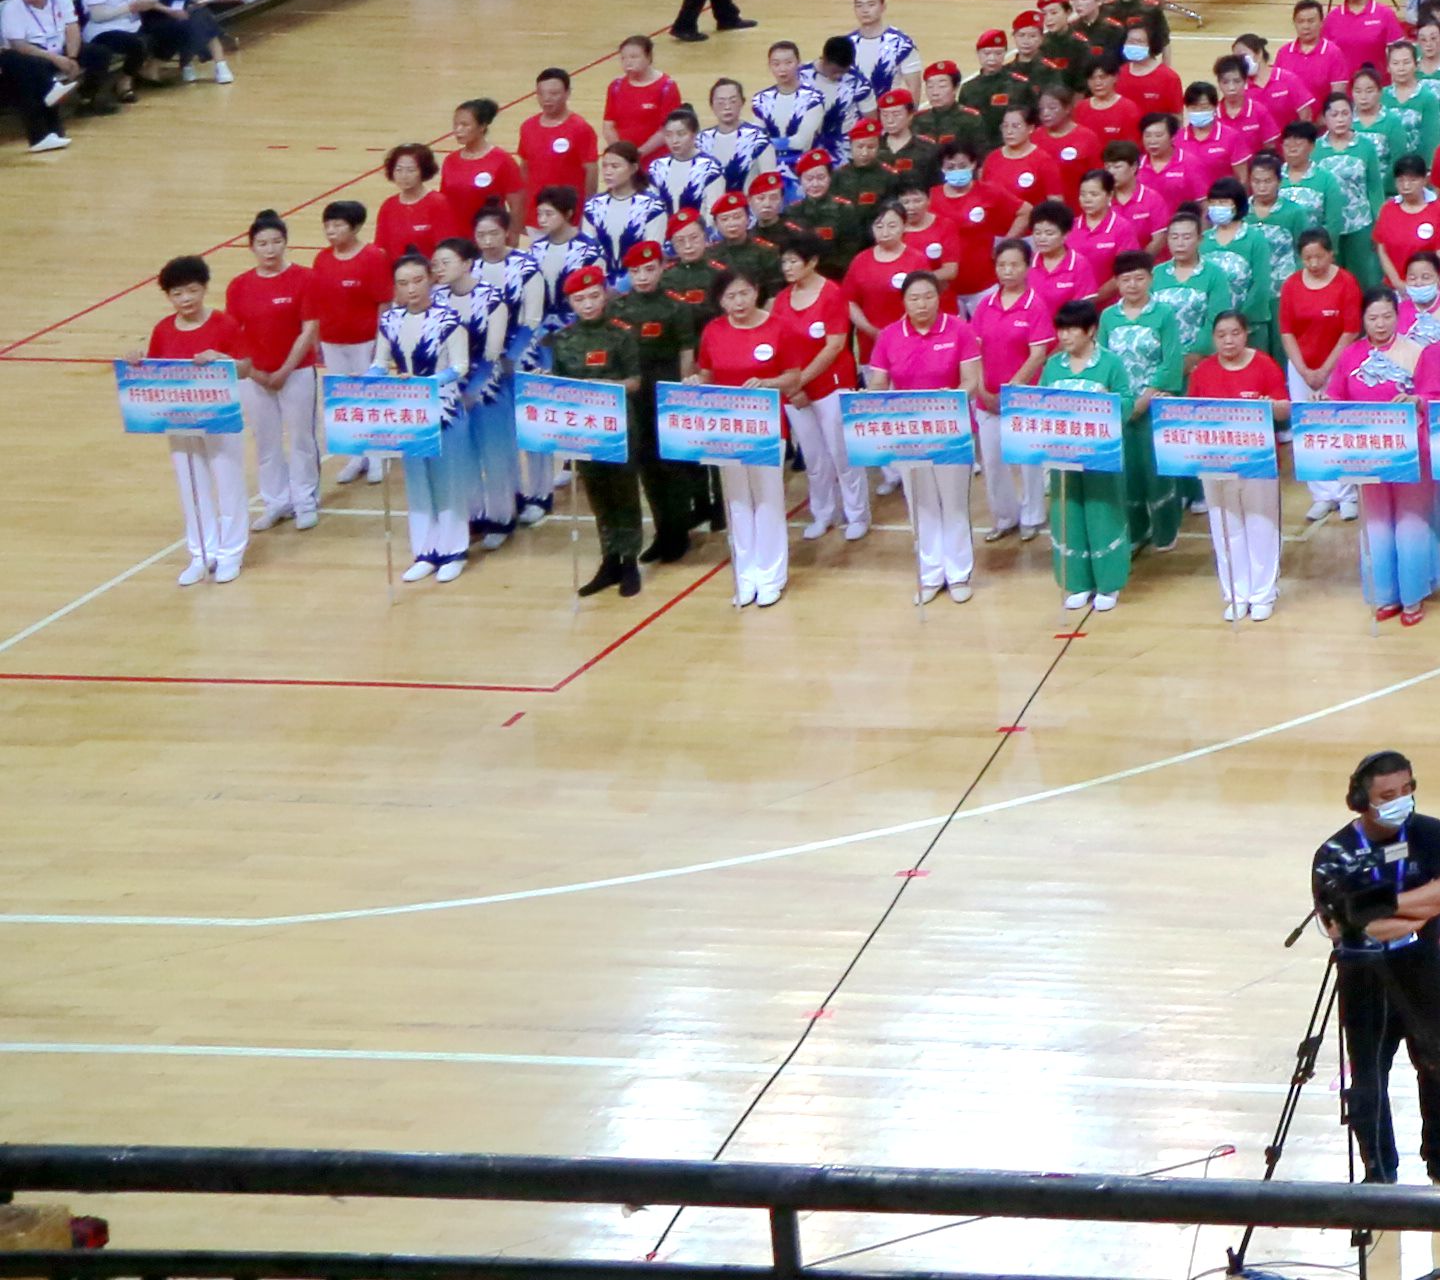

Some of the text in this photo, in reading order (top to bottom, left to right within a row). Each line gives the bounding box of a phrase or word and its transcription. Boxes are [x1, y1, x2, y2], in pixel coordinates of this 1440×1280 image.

[334, 407, 429, 423] 威海市代表队
